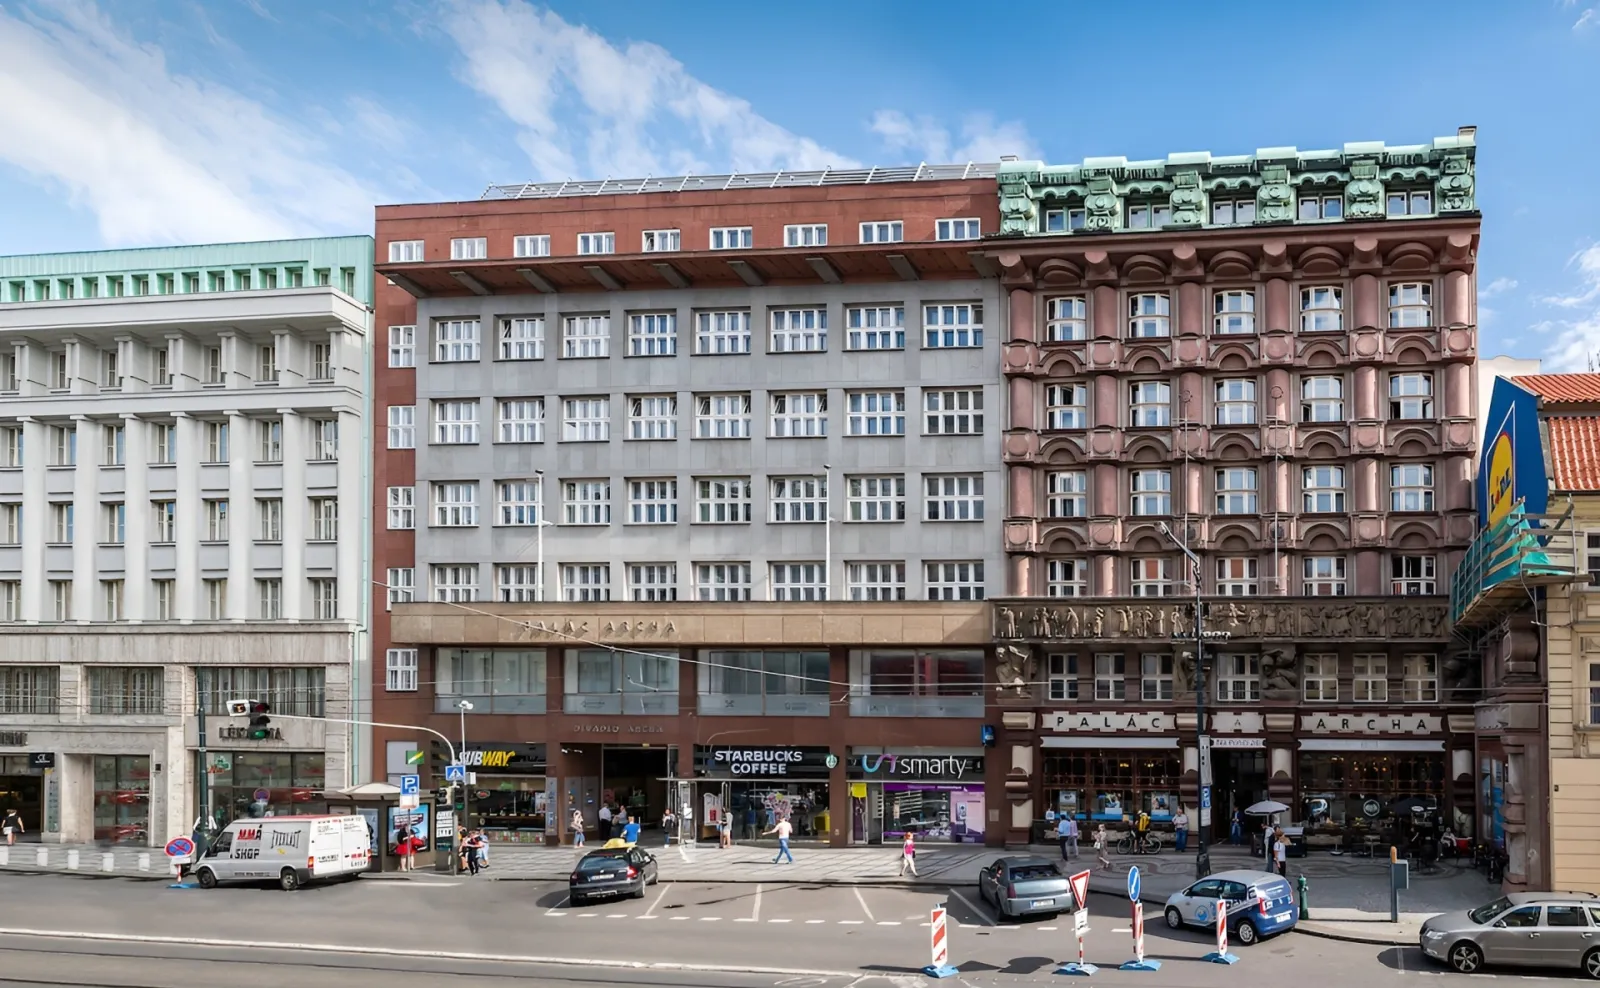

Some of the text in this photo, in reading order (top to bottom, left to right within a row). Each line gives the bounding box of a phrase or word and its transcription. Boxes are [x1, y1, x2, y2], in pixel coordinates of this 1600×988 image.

[1056, 714, 1161, 729] PALÁC
[1316, 718, 1427, 730] ARCHA
[459, 750, 515, 767] SUBWAY
[714, 750, 803, 762] STARBUCKS
[731, 763, 787, 774] COFFEE
[900, 755, 967, 779] smarty
[404, 777, 416, 790] P
[235, 848, 260, 859] SHOP
